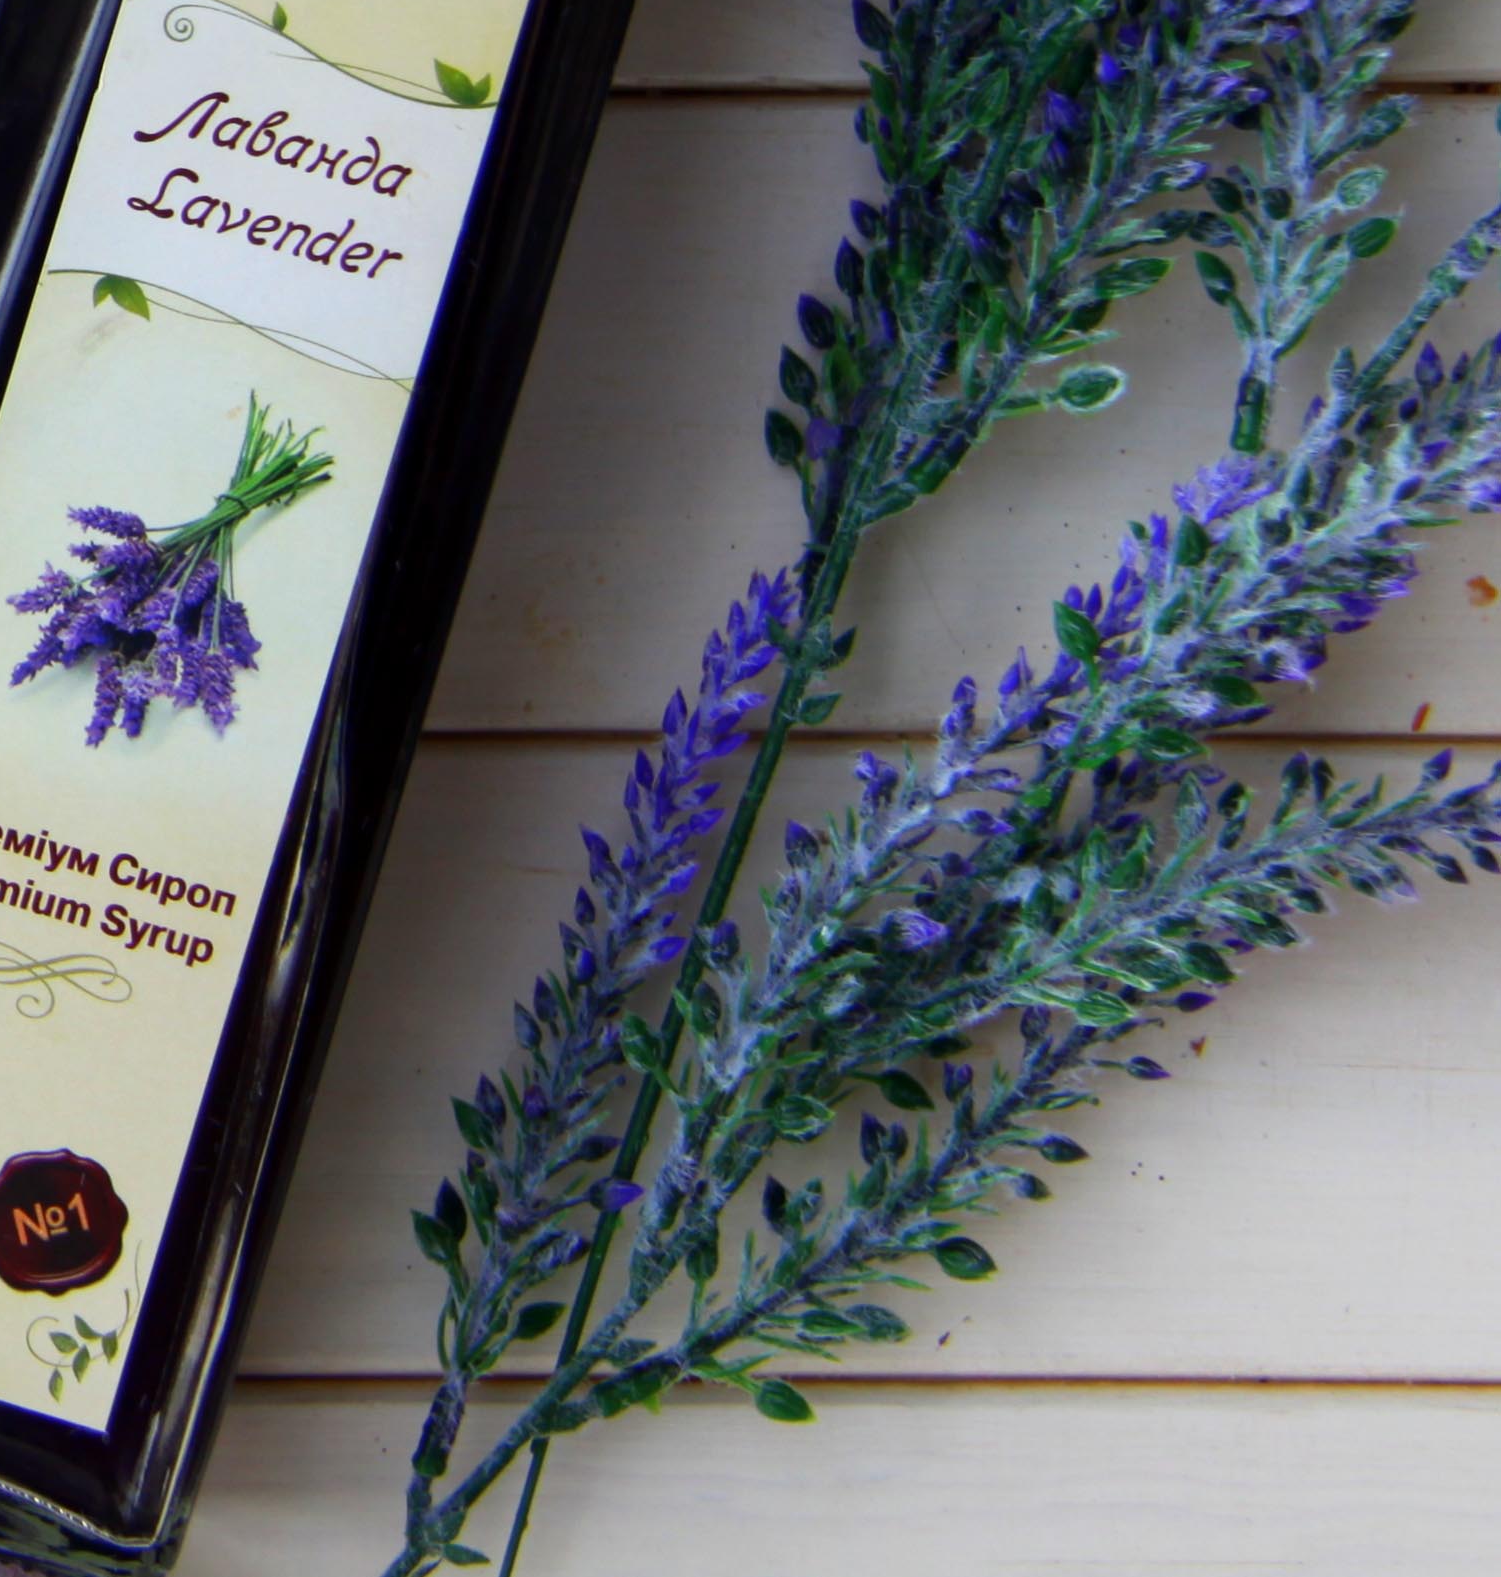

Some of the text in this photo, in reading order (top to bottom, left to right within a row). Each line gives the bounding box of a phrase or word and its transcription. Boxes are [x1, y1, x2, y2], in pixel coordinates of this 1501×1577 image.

[133, 91, 413, 197] Лаванда
[126, 167, 404, 278] Lavender
[108, 852, 238, 917] Сироп
[100, 902, 215, 967] Syrup
[11, 1191, 91, 1247] №1
